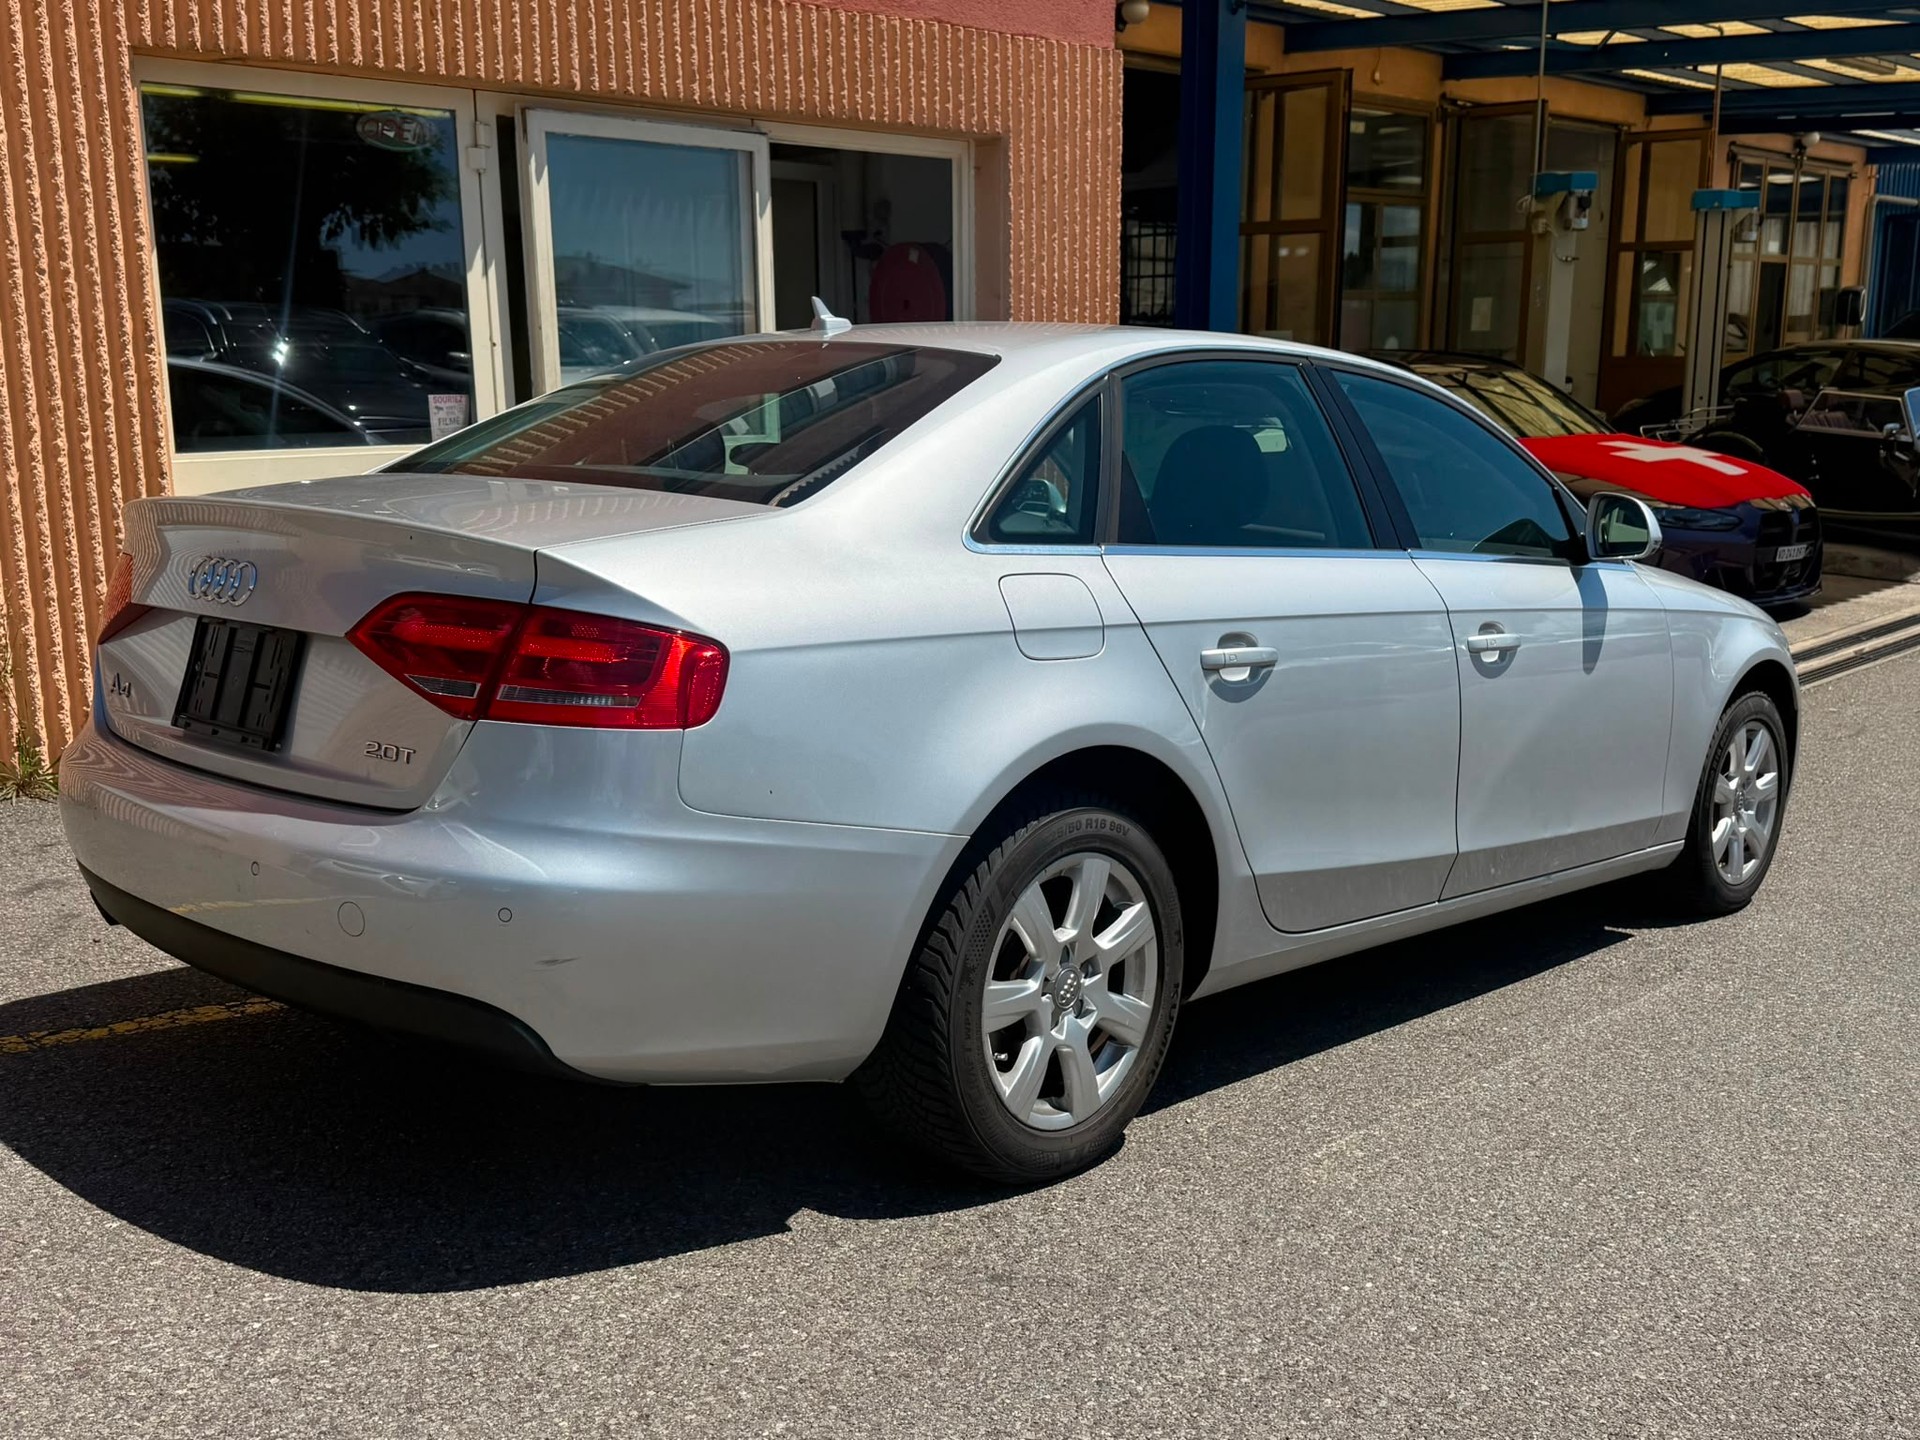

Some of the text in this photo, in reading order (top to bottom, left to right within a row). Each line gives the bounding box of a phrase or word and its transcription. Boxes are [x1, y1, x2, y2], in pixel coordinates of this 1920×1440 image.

[432, 396, 464, 405] SOURIEZ
[110, 672, 132, 698] A4
[363, 740, 417, 765] 2.0T
[1085, 818, 1107, 830] R16
